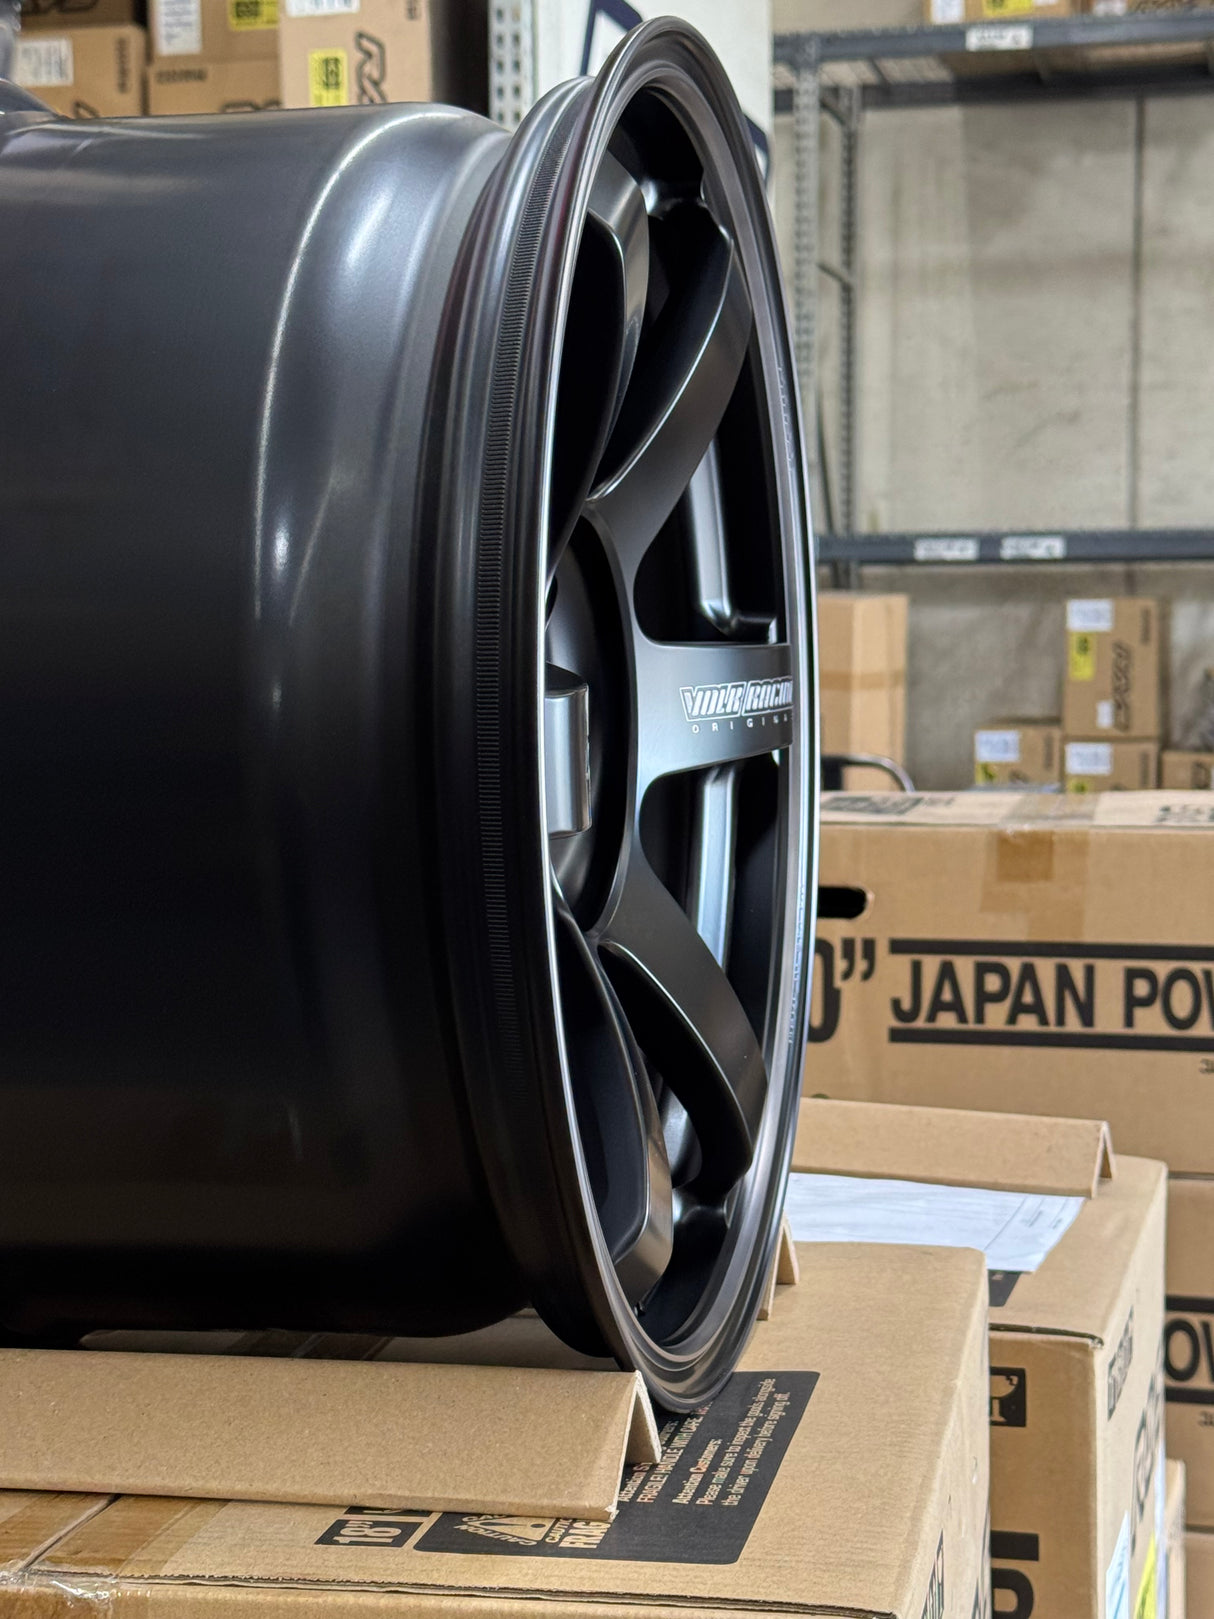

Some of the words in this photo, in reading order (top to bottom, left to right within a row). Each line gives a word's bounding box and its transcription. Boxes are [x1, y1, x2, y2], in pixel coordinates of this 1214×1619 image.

[890, 958, 1096, 1029] JAPAN
[1124, 966, 1214, 1031] PO
[752, 1379, 776, 1402] alongside
[746, 1402, 765, 1417] goods
[764, 1401, 791, 1420] signing
[738, 1417, 757, 1427] the
[753, 1420, 778, 1437] before
[727, 1427, 752, 1445] inspect
[654, 1448, 684, 1474] HANDLE
[669, 1432, 694, 1448] WITH
[744, 1437, 773, 1459] delivery
[720, 1453, 738, 1467] sure
[740, 1459, 760, 1475] upon
[711, 1467, 731, 1483] make
[672, 1473, 704, 1505] Attention
[726, 1475, 751, 1494] driver
[695, 1484, 722, 1505] Please
[720, 1494, 742, 1506] the
